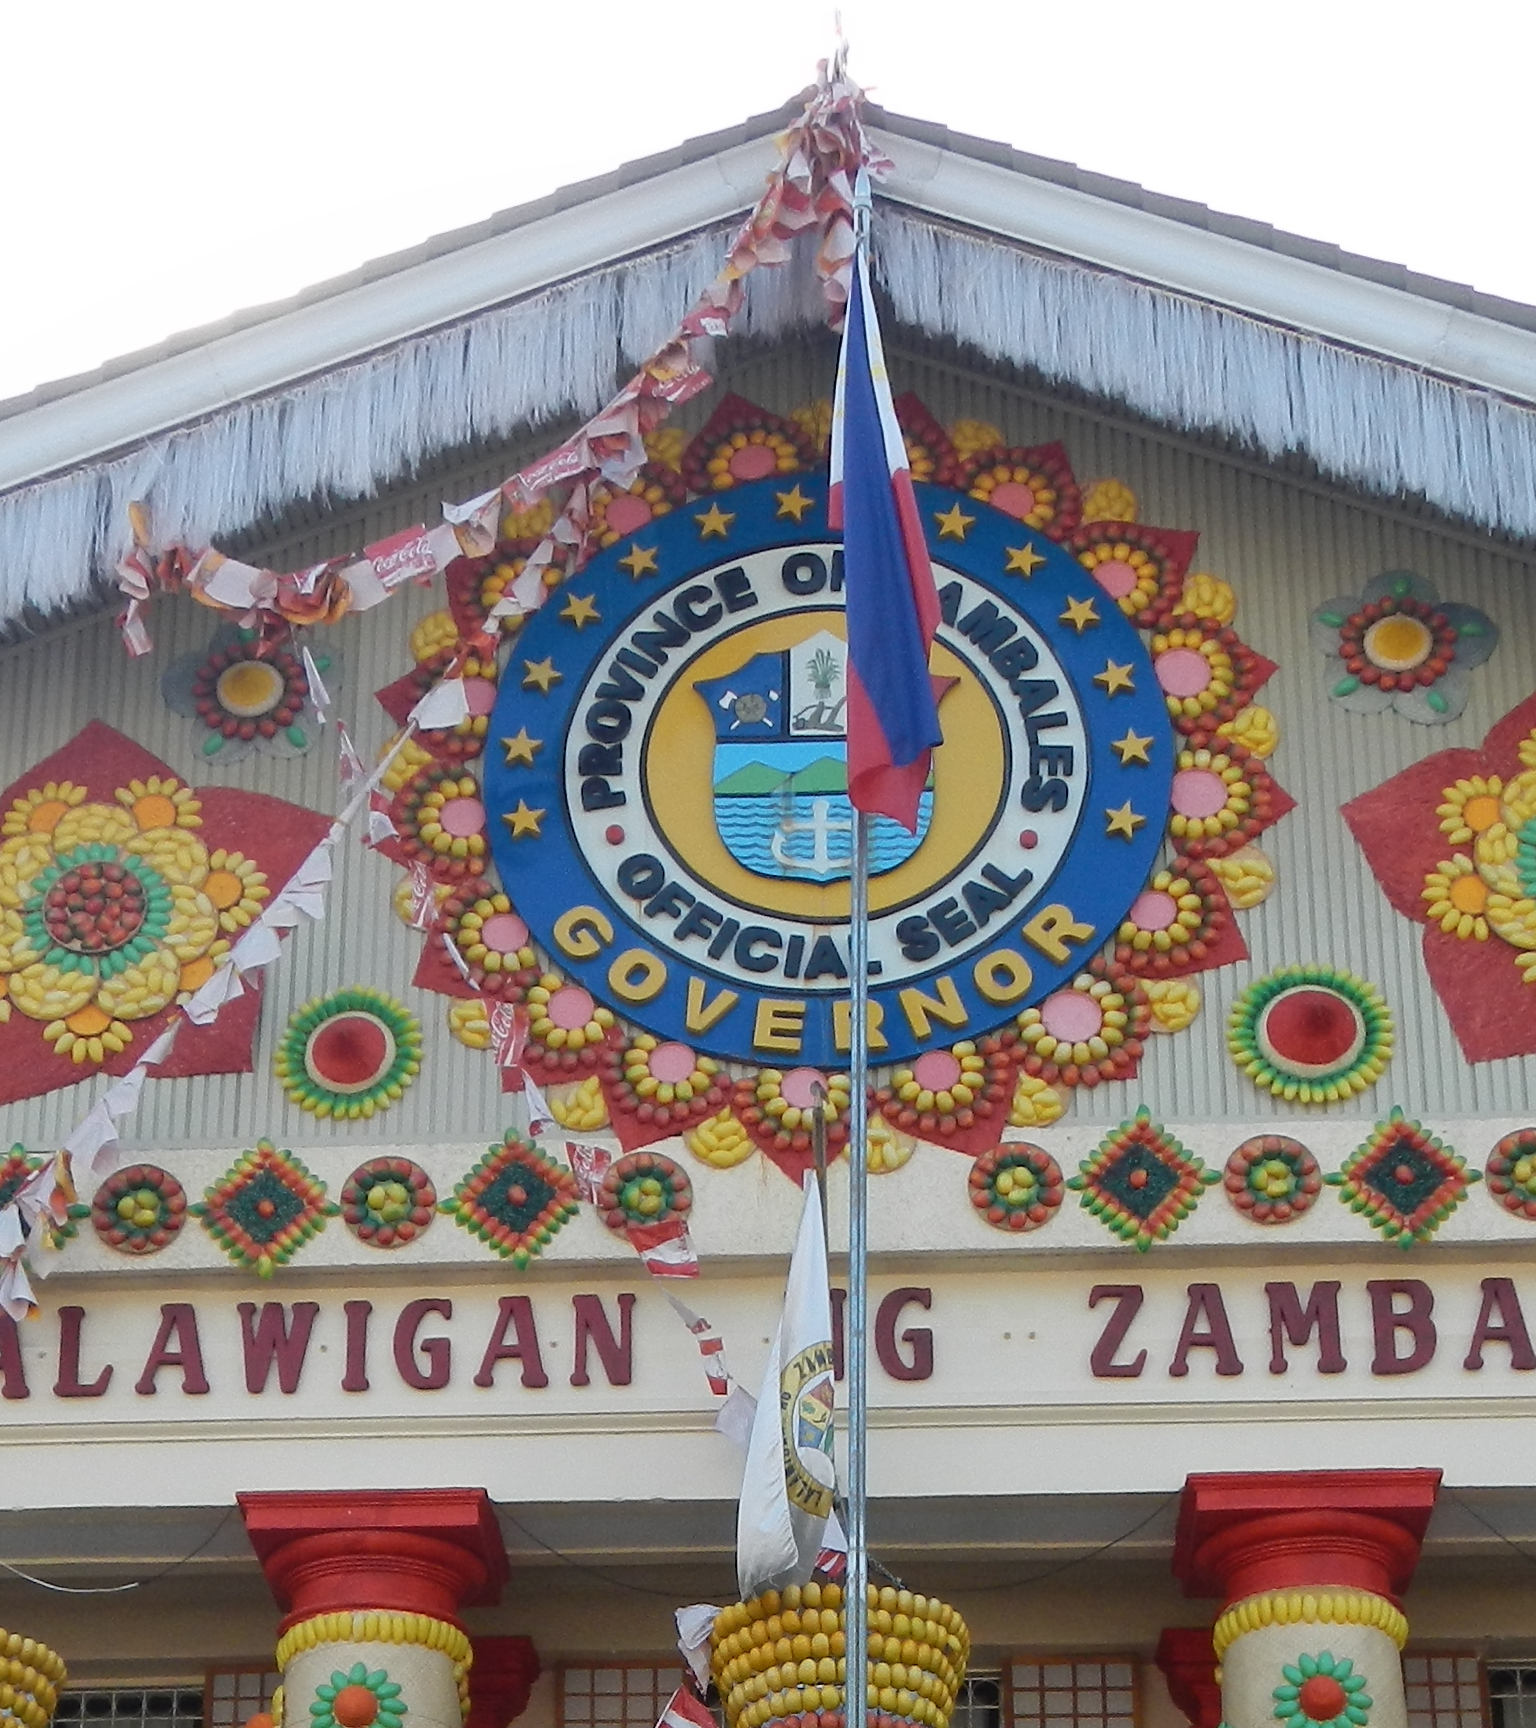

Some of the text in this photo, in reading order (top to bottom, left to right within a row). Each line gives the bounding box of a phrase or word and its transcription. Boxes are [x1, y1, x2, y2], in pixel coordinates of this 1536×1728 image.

[577, 565, 759, 812] PROVINCE
[938, 580, 1074, 813] AMBALES
[553, 903, 1096, 1053] GOVERNOR
[895, 862, 1034, 962] SEAL
